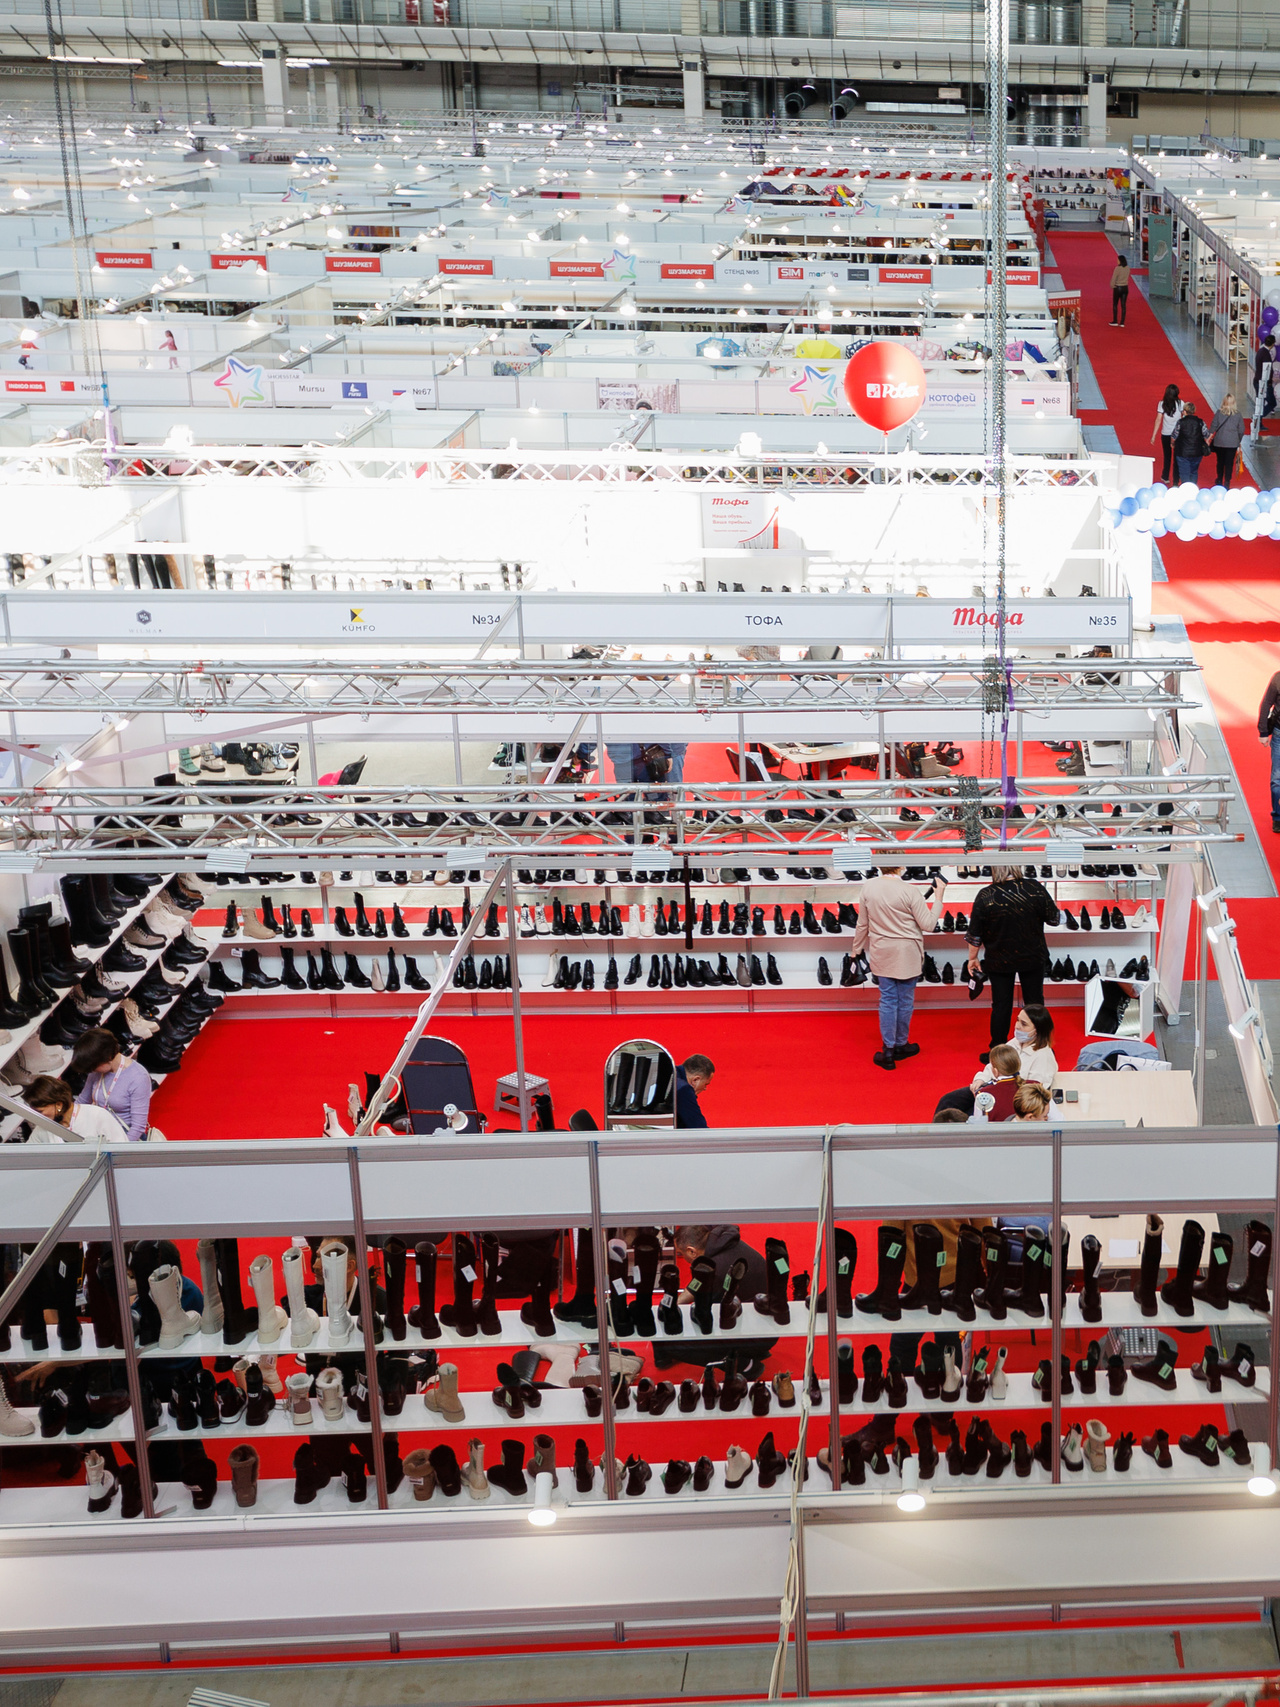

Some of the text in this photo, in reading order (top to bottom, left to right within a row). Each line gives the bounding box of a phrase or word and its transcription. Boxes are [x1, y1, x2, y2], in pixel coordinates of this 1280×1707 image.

[780, 268, 801, 277] SIM
[886, 272, 924, 280] ШУЗМАРКЕТ
[298, 385, 325, 393] Mursu
[412, 388, 432, 396] №67
[929, 392, 976, 404] котофей
[1042, 397, 1061, 405] №68
[472, 614, 501, 625] №34
[744, 615, 783, 626] ТОФА
[1088, 616, 1117, 626] №35
